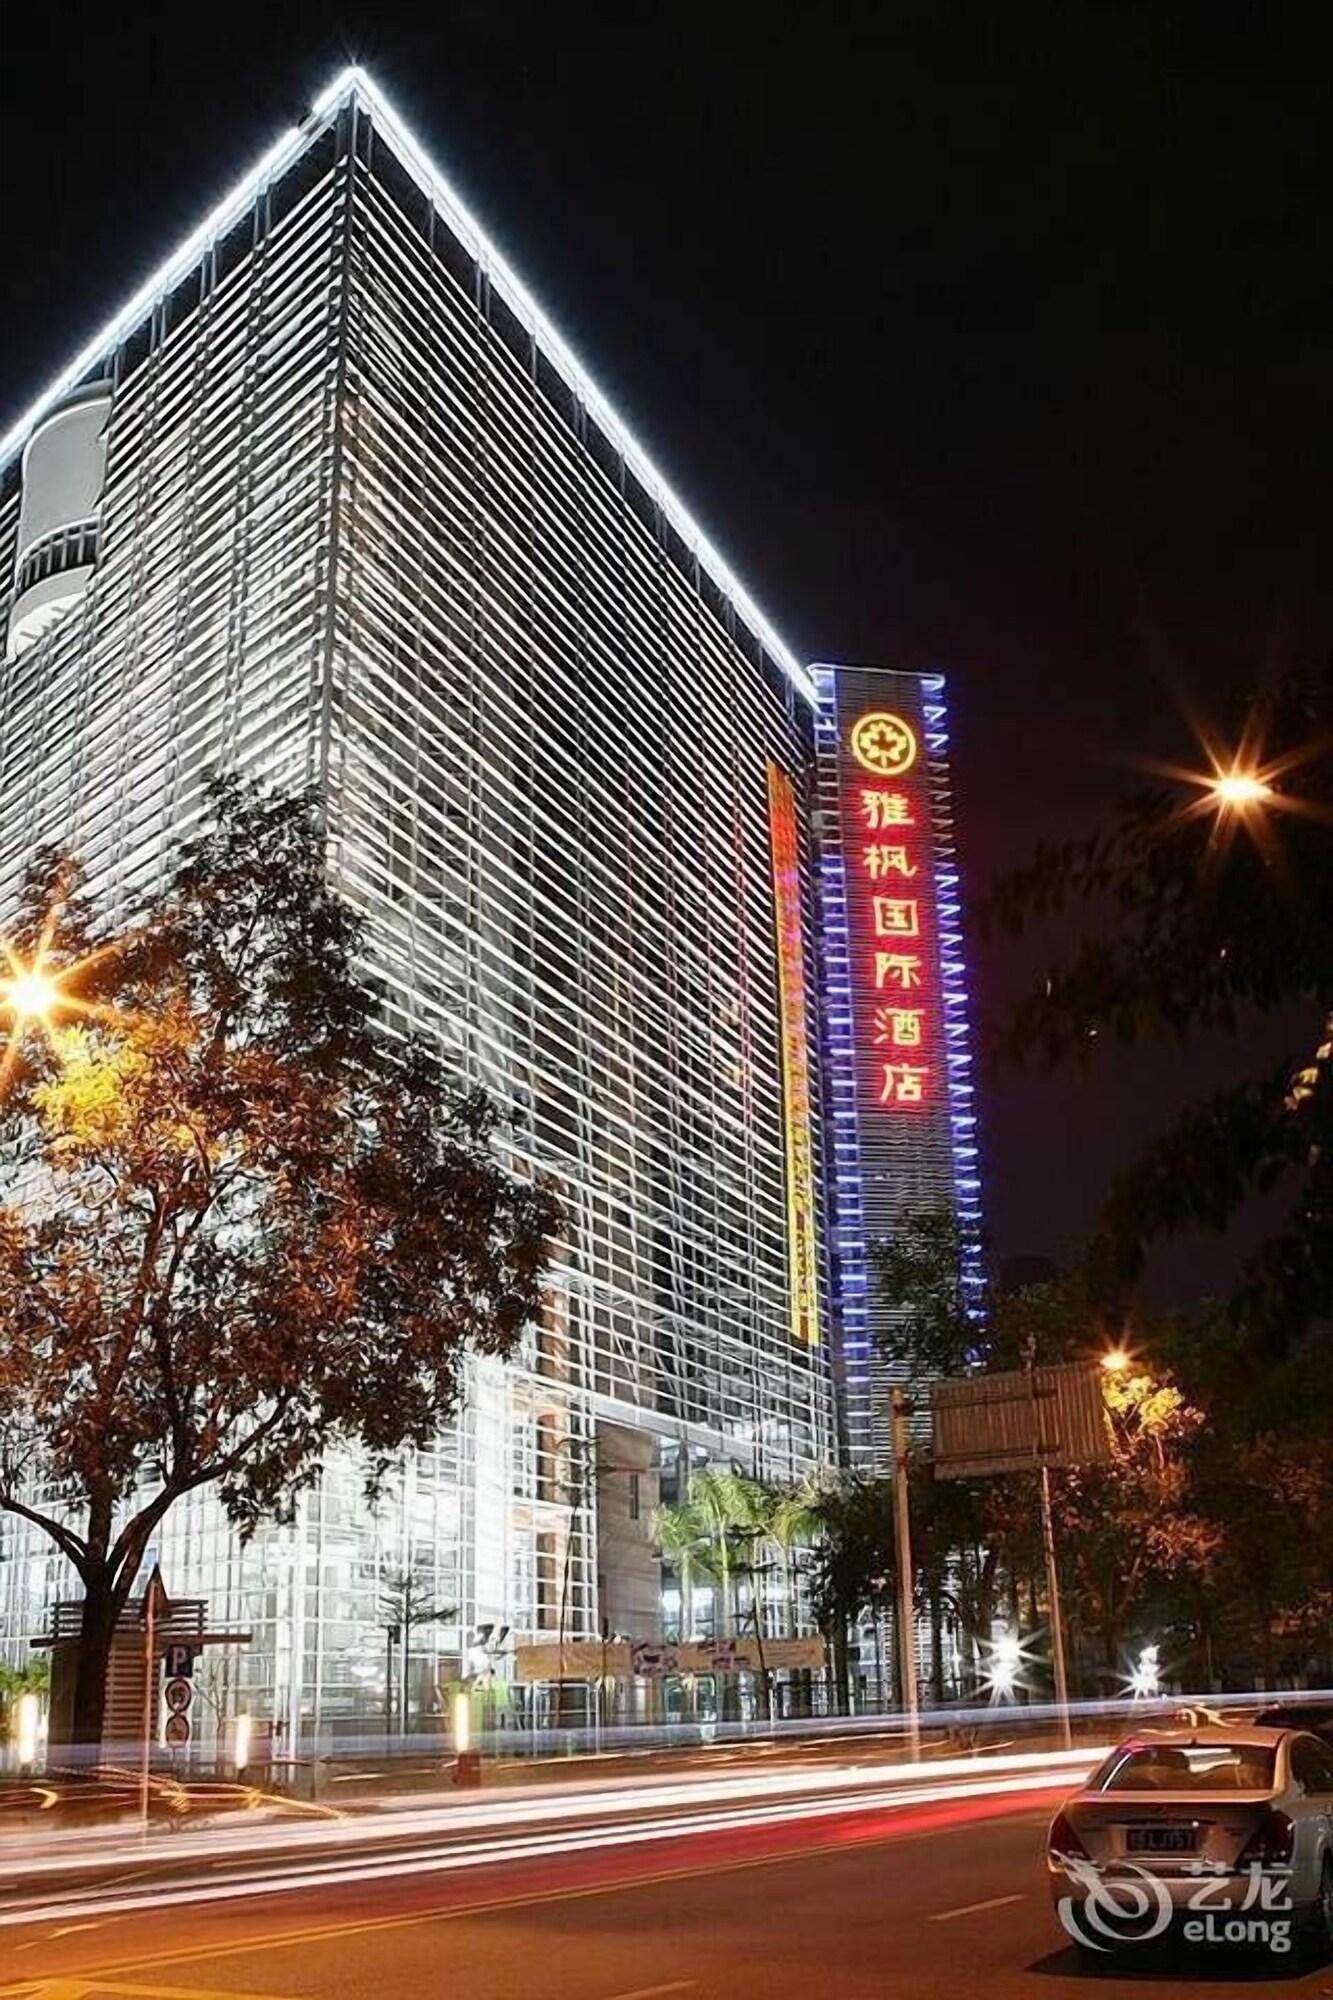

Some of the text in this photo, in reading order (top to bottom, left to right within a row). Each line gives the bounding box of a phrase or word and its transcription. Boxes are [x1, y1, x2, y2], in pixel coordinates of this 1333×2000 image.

[861, 790, 928, 1102] 雅枫国际酒店
[172, 1647, 187, 1674] P
